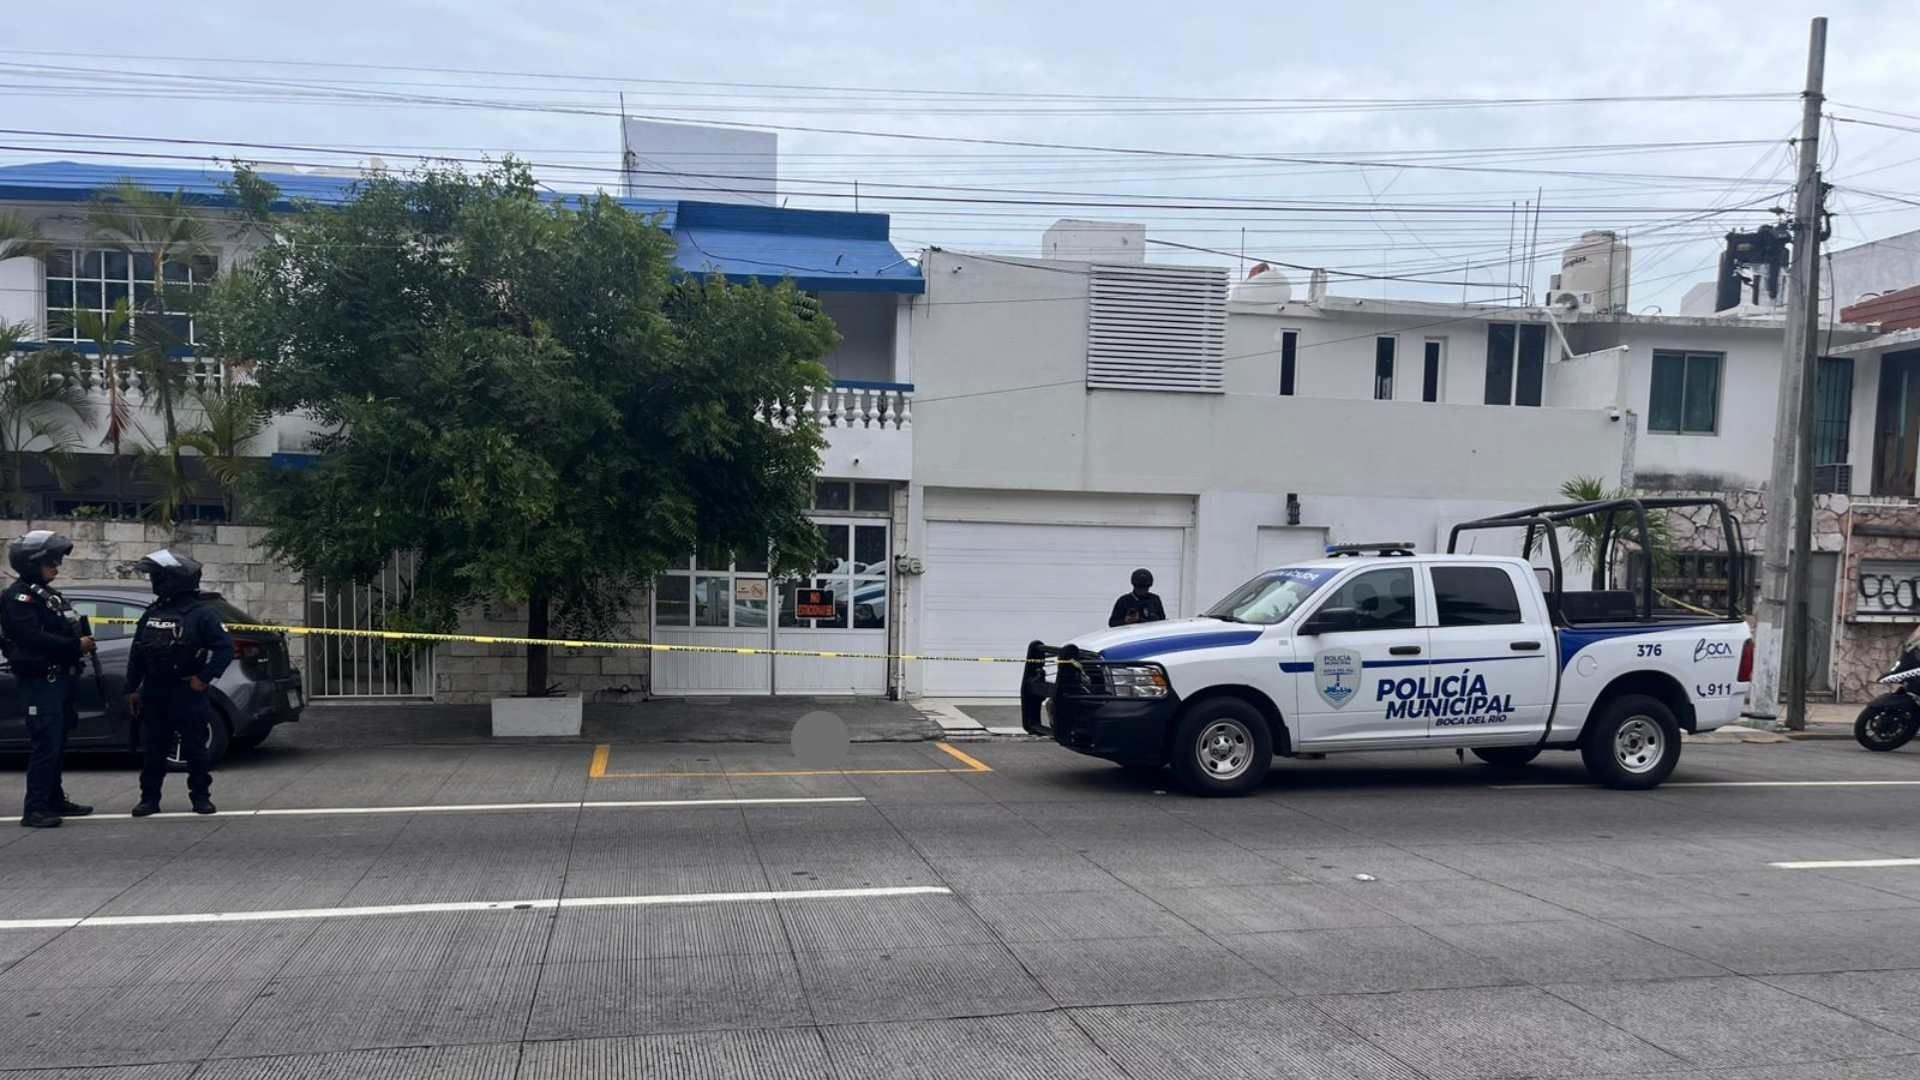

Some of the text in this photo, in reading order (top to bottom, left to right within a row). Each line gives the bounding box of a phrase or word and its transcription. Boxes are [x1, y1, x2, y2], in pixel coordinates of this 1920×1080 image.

[1637, 644, 1662, 656] 376
[1693, 638, 1732, 662] BOCA
[1376, 668, 1488, 702] POLICÍA
[1707, 683, 1732, 696] 911
[1385, 694, 1515, 720] MUNICIPAL
[1435, 717, 1465, 727] BOCA
[1467, 715, 1487, 725] DEL
